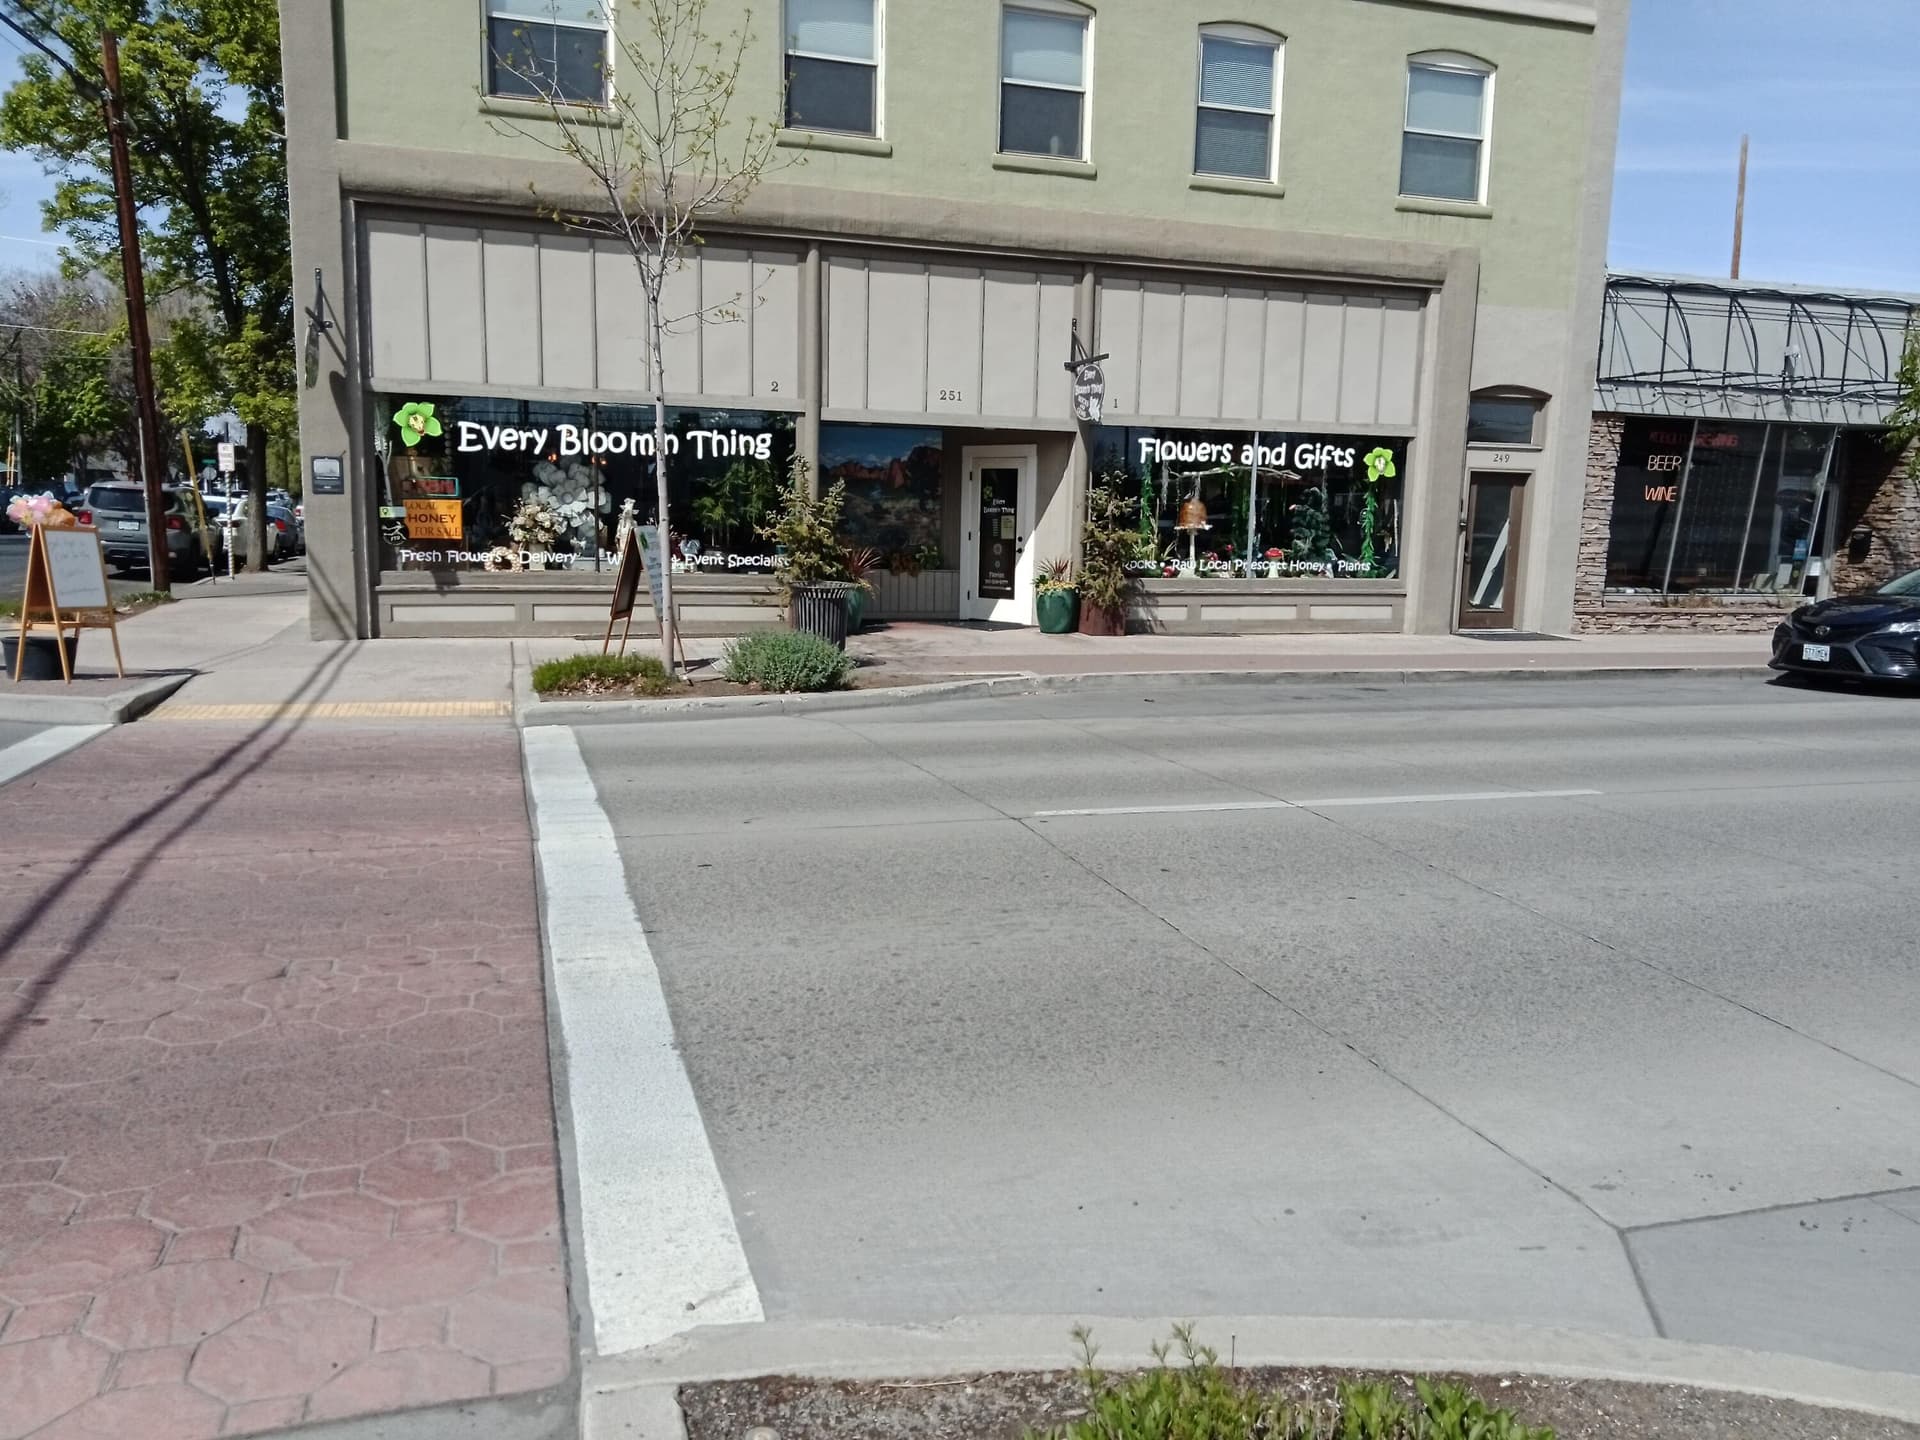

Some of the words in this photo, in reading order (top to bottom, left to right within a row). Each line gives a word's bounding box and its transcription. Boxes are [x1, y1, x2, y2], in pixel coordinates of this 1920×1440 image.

[770, 380, 779, 392] 2
[940, 389, 962, 402] 251
[457, 421, 548, 455] Every
[556, 424, 679, 456] Bloomn
[686, 429, 773, 460] Thing
[1138, 437, 1233, 464] Flowers
[1240, 442, 1286, 466] and
[1294, 443, 1355, 470] Gifts
[1647, 455, 1682, 471] BEER
[1645, 485, 1678, 502] WINE
[408, 514, 457, 523] HONEY
[415, 527, 434, 537] FOR
[436, 527, 460, 537] SALE
[400, 549, 441, 562] Fresh
[446, 550, 502, 563] Flowers
[520, 551, 577, 564] Delivery
[685, 554, 724, 566] Event
[1171, 559, 1196, 570] Raw
[1200, 560, 1231, 571] Local
[1290, 560, 1325, 571] Honey
[1337, 560, 1370, 571] Plants
